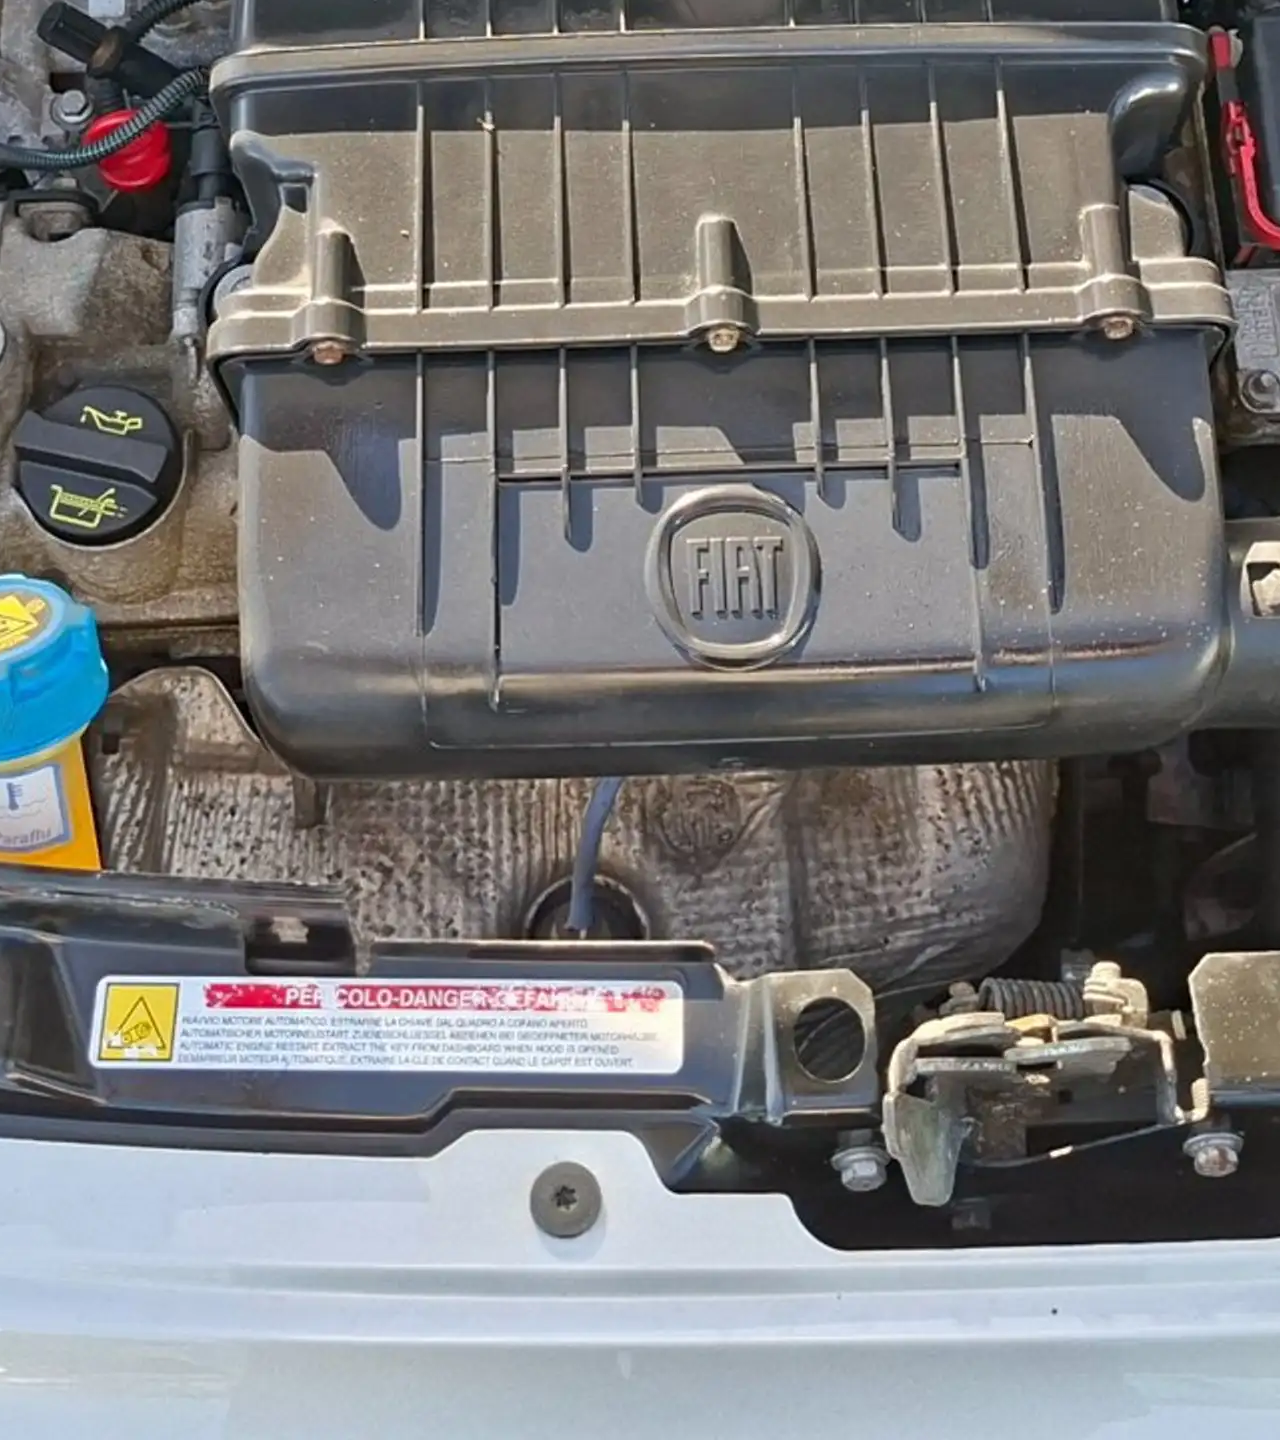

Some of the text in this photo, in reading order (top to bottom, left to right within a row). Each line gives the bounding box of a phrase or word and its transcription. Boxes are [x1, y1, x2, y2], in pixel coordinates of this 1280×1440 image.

[686, 536, 784, 619] FIAT
[180, 1041, 236, 1051] AUTOMATIC
[369, 1042, 387, 1052] THE
[390, 1042, 410, 1052] KEY
[411, 1043, 440, 1053] FROM
[503, 1044, 532, 1054] WHEN
[446, 1056, 491, 1066] CONTACT
